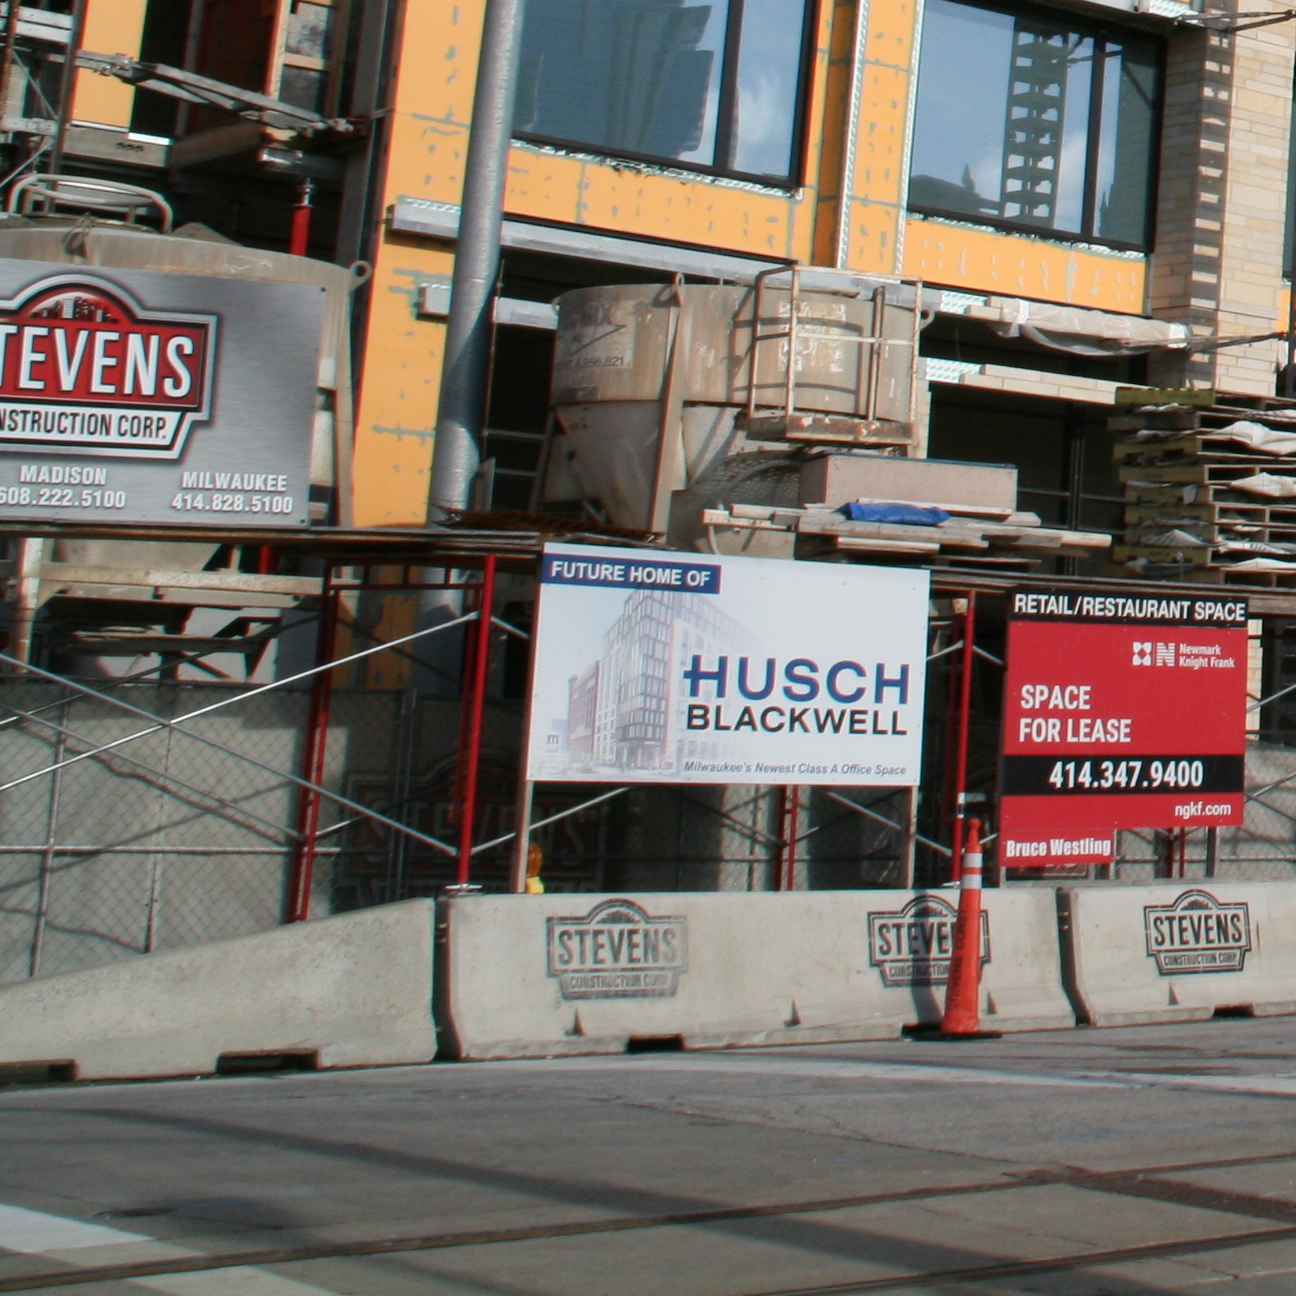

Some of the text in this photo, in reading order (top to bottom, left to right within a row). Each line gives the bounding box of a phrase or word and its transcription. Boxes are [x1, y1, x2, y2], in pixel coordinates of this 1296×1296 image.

[0, 325, 195, 398] TEVENS
[0, 408, 167, 440] NSTRUCTION CORP.
[20, 464, 108, 486] MADISON
[182, 471, 289, 493] MILWAUKEE
[0, 486, 126, 509] 608.222.5100
[171, 492, 294, 514] 414.828.5100
[551, 561, 711, 587] FUTURE HOME OF
[1014, 593, 1246, 621] RETAIL/RESTAURANT SPACE
[1179, 643, 1222, 655] Newmark
[1179, 656, 1235, 670] Knight Frank
[683, 654, 910, 704] HUSCH
[1020, 684, 1091, 710] SPACE
[686, 704, 908, 735] BLACKWELL
[1019, 718, 1132, 743] FOR LEASE
[684, 760, 907, 777] Milwaukee's Newest Class A Office Space
[1048, 760, 1204, 789] 414.347.9400
[1174, 801, 1232, 820] ngkf.com
[1006, 837, 1111, 858] Bruce Westling
[878, 921, 957, 955] STEVE
[1153, 912, 1242, 946] STEVENS
[558, 927, 677, 965] STEVENS
